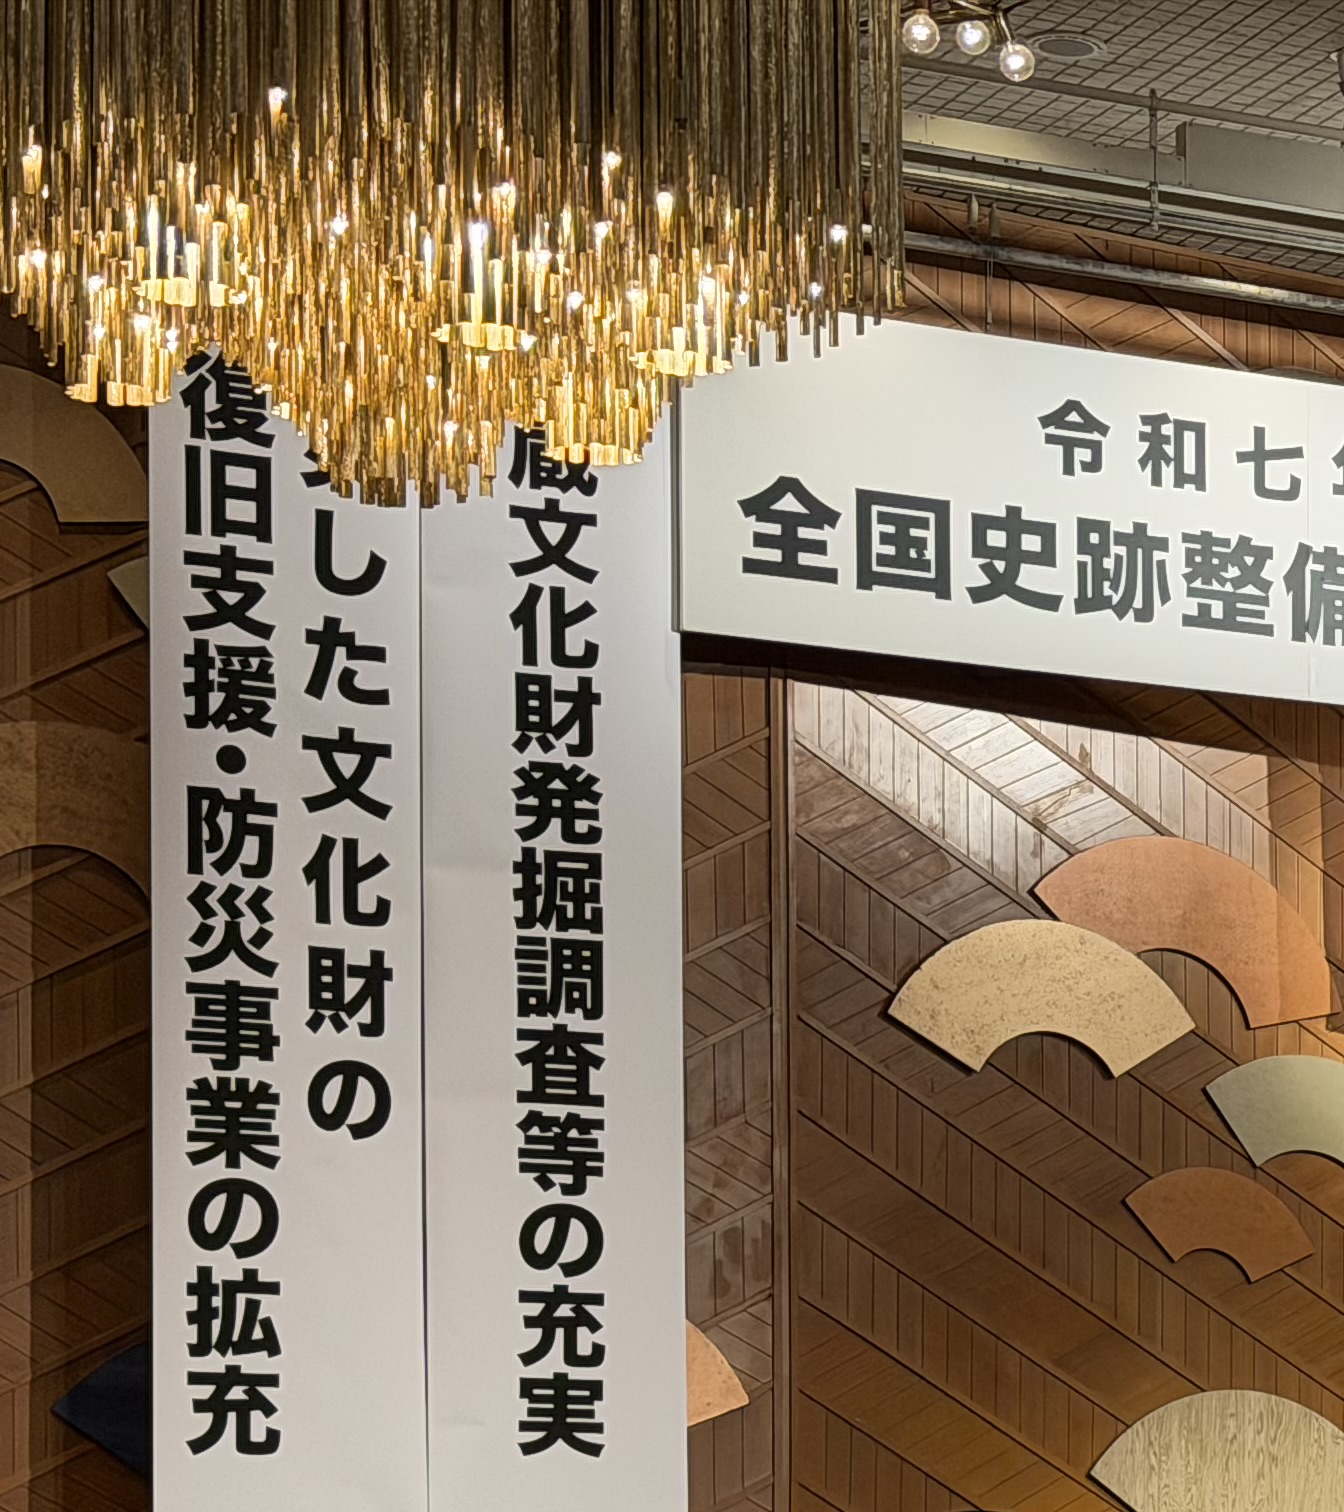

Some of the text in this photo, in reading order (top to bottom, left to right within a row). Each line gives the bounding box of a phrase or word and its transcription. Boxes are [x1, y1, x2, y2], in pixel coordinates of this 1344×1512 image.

[299, 449, 394, 1142] した文化財の
